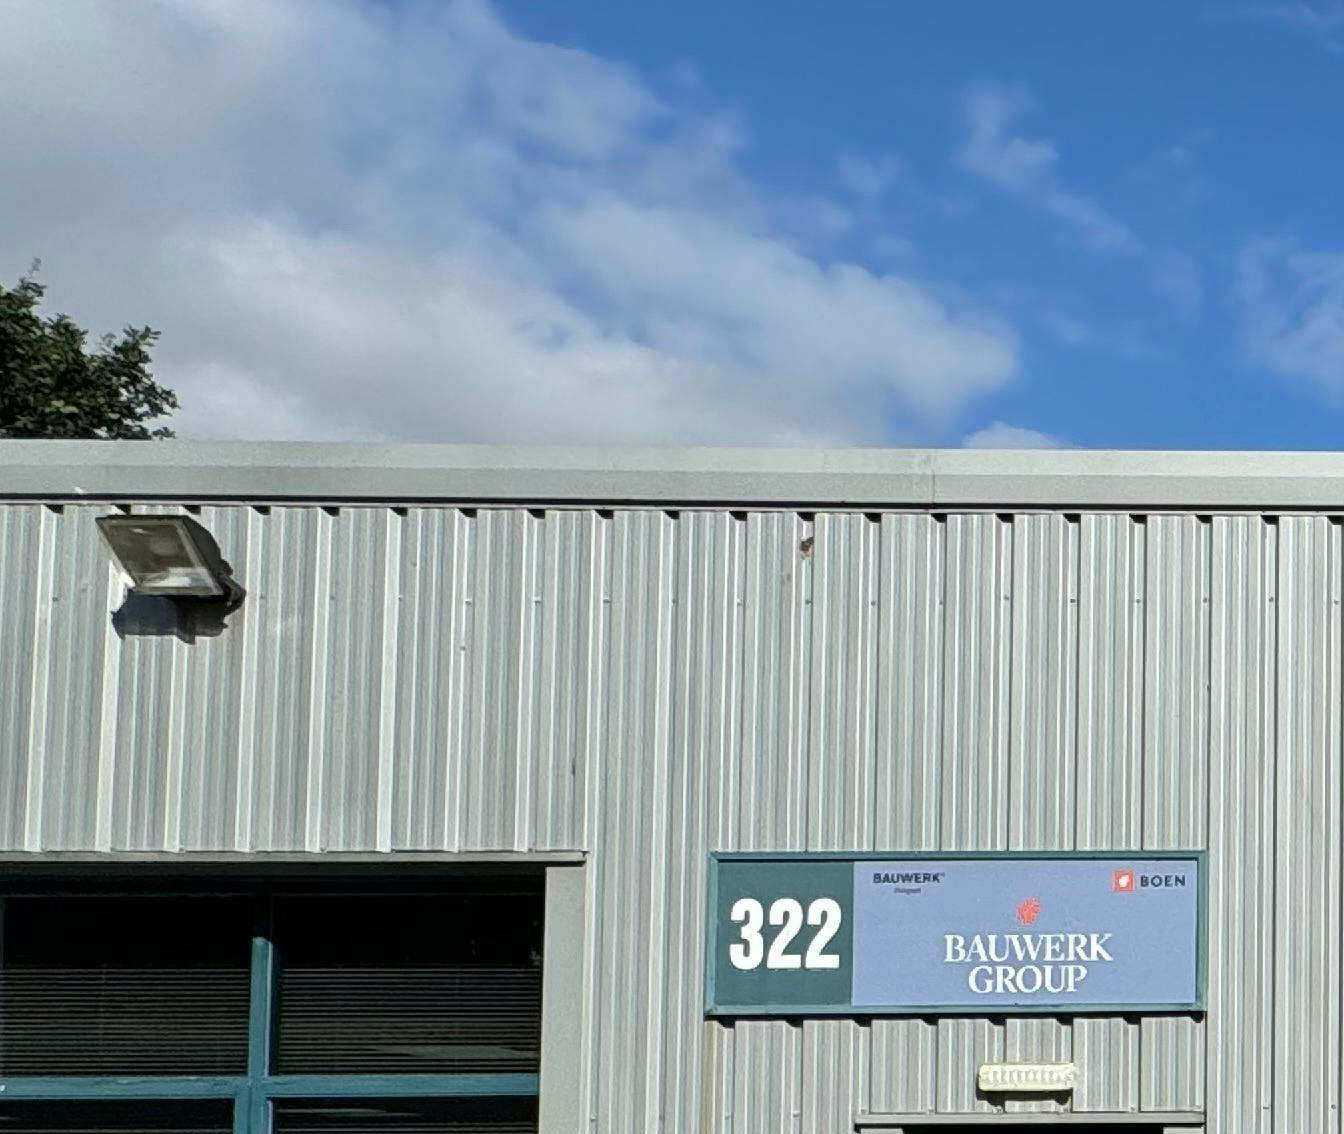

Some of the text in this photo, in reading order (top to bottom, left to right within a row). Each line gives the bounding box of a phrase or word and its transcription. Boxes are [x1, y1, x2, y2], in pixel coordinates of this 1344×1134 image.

[872, 872, 945, 884] BAUWERK
[1140, 874, 1186, 887] BOEN
[729, 898, 842, 970] 322
[943, 933, 1114, 963] BAUWERK
[968, 964, 1088, 994] GROUP
